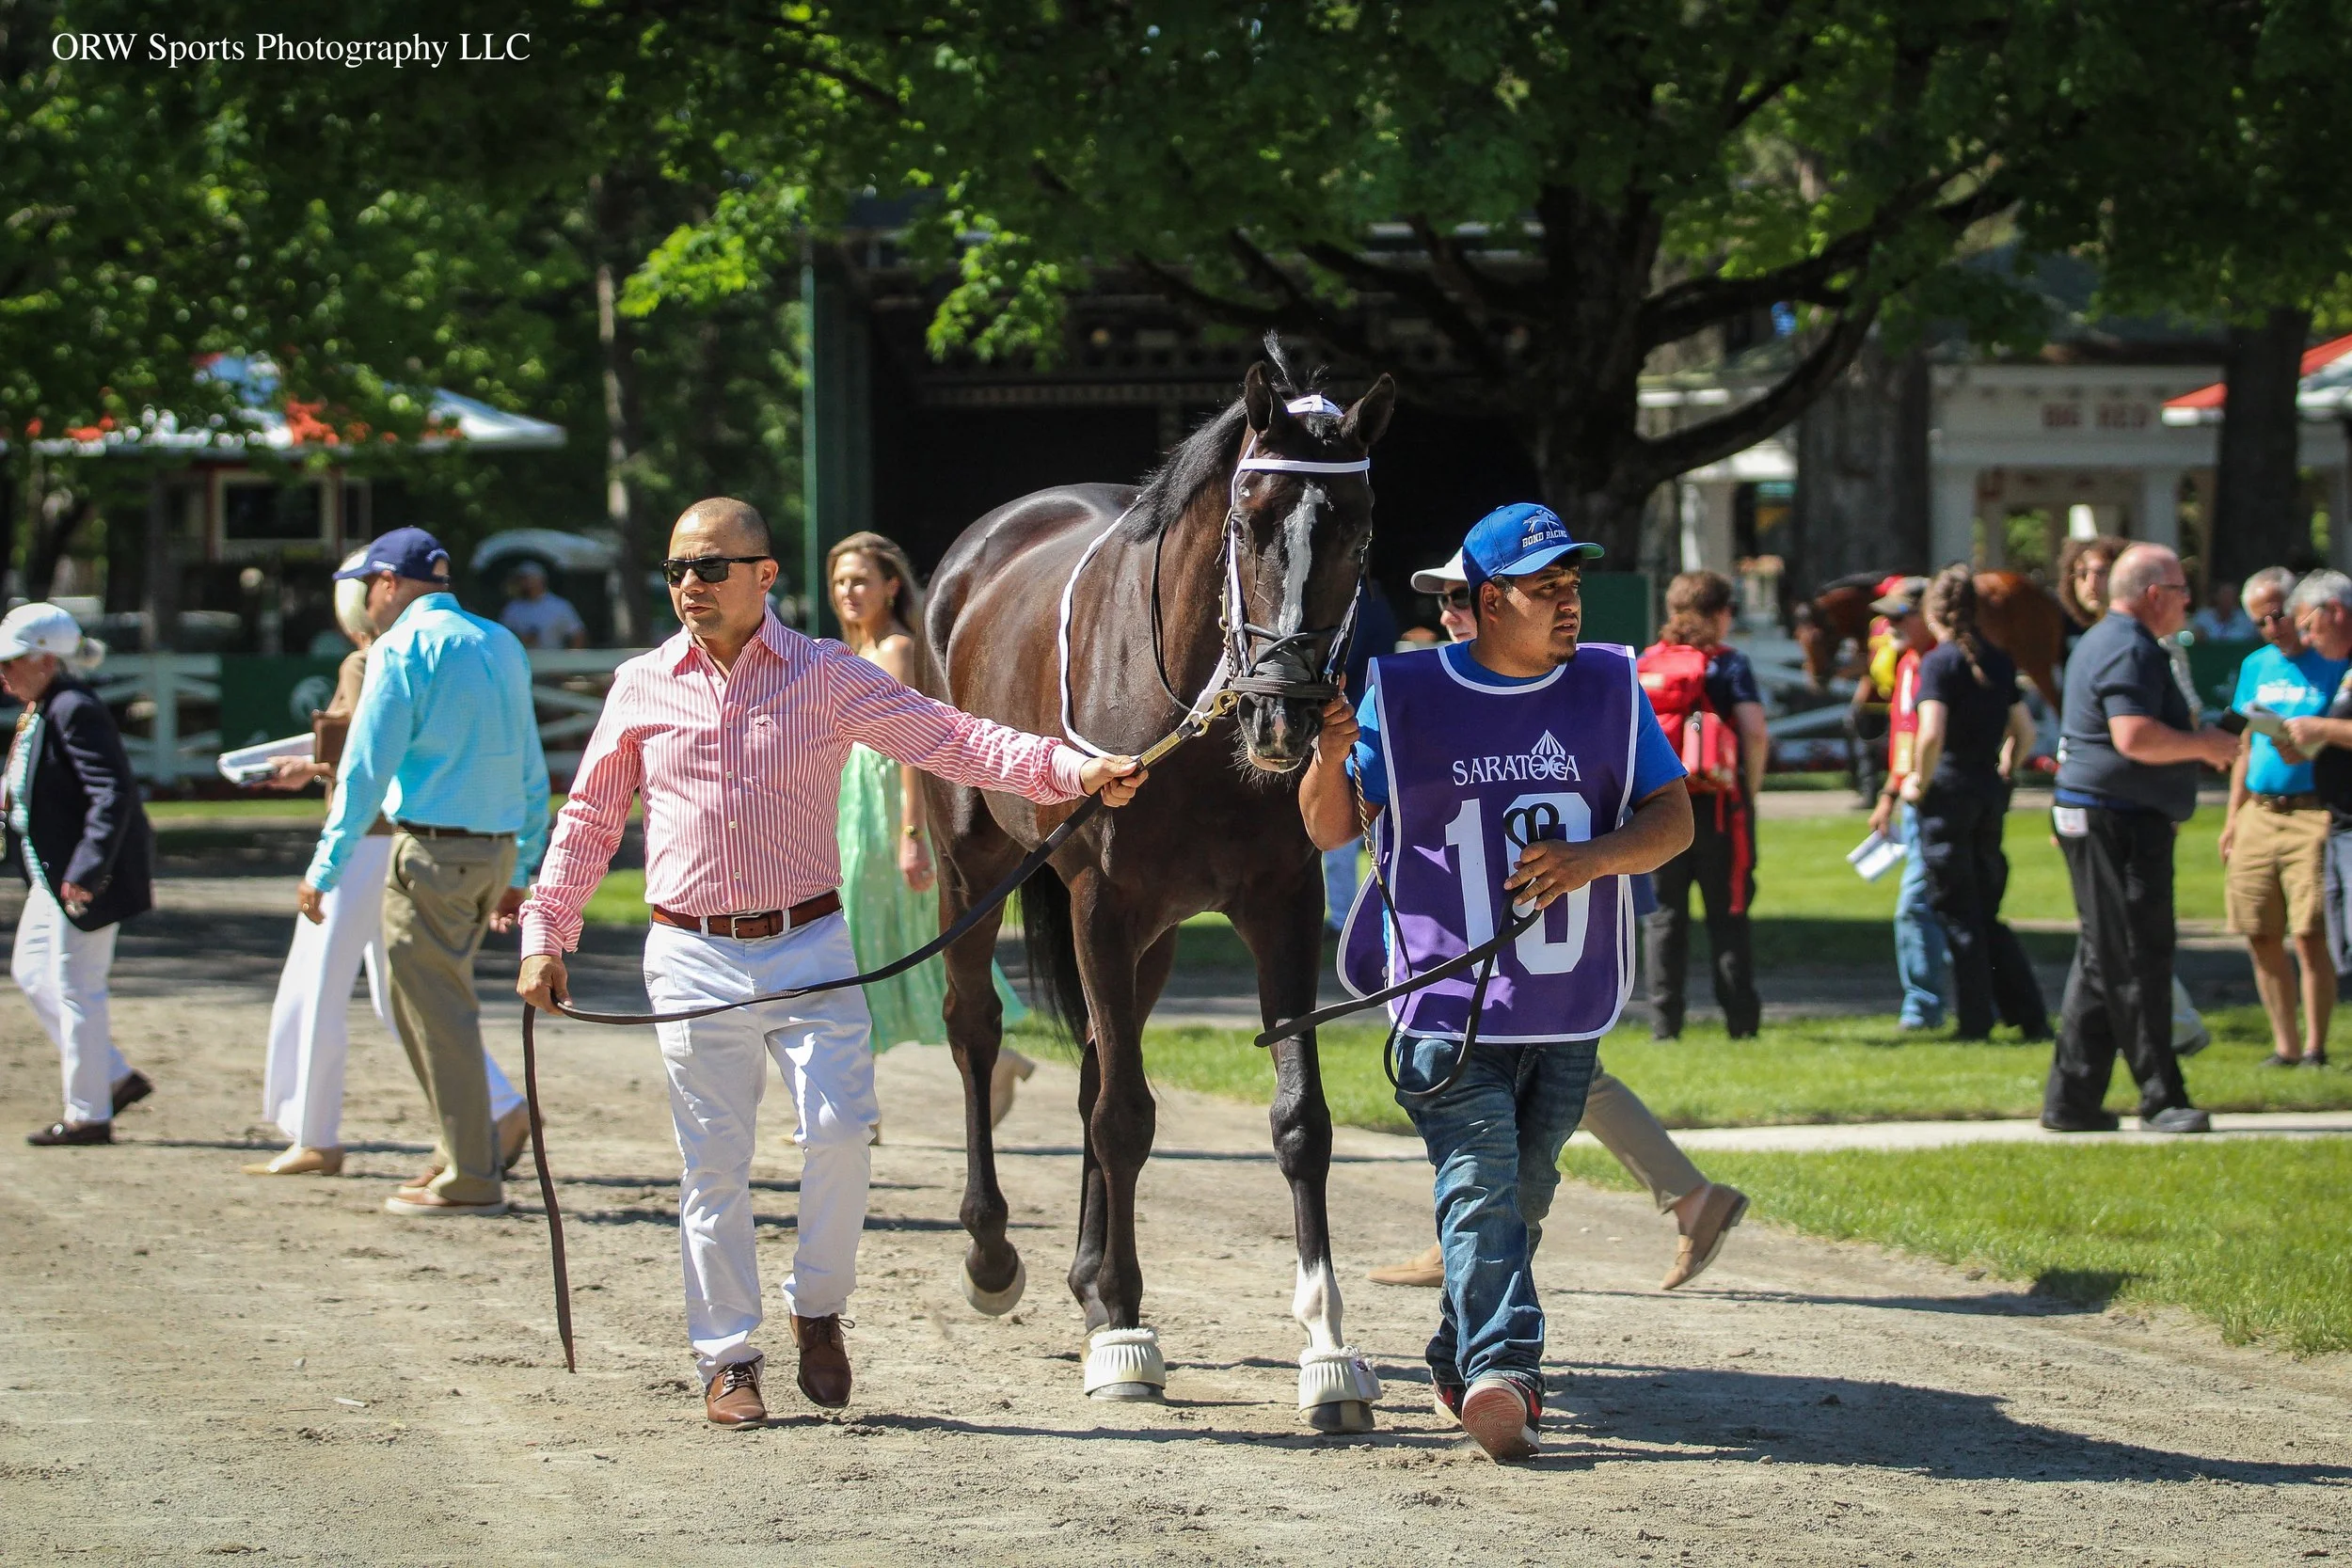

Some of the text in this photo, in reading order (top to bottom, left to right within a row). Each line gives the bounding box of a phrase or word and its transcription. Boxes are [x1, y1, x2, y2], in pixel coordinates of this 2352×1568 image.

[1521, 530, 1568, 548] BOND RACING
[1452, 752, 1581, 786] SARATOGA
[1444, 792, 1592, 979] 10
